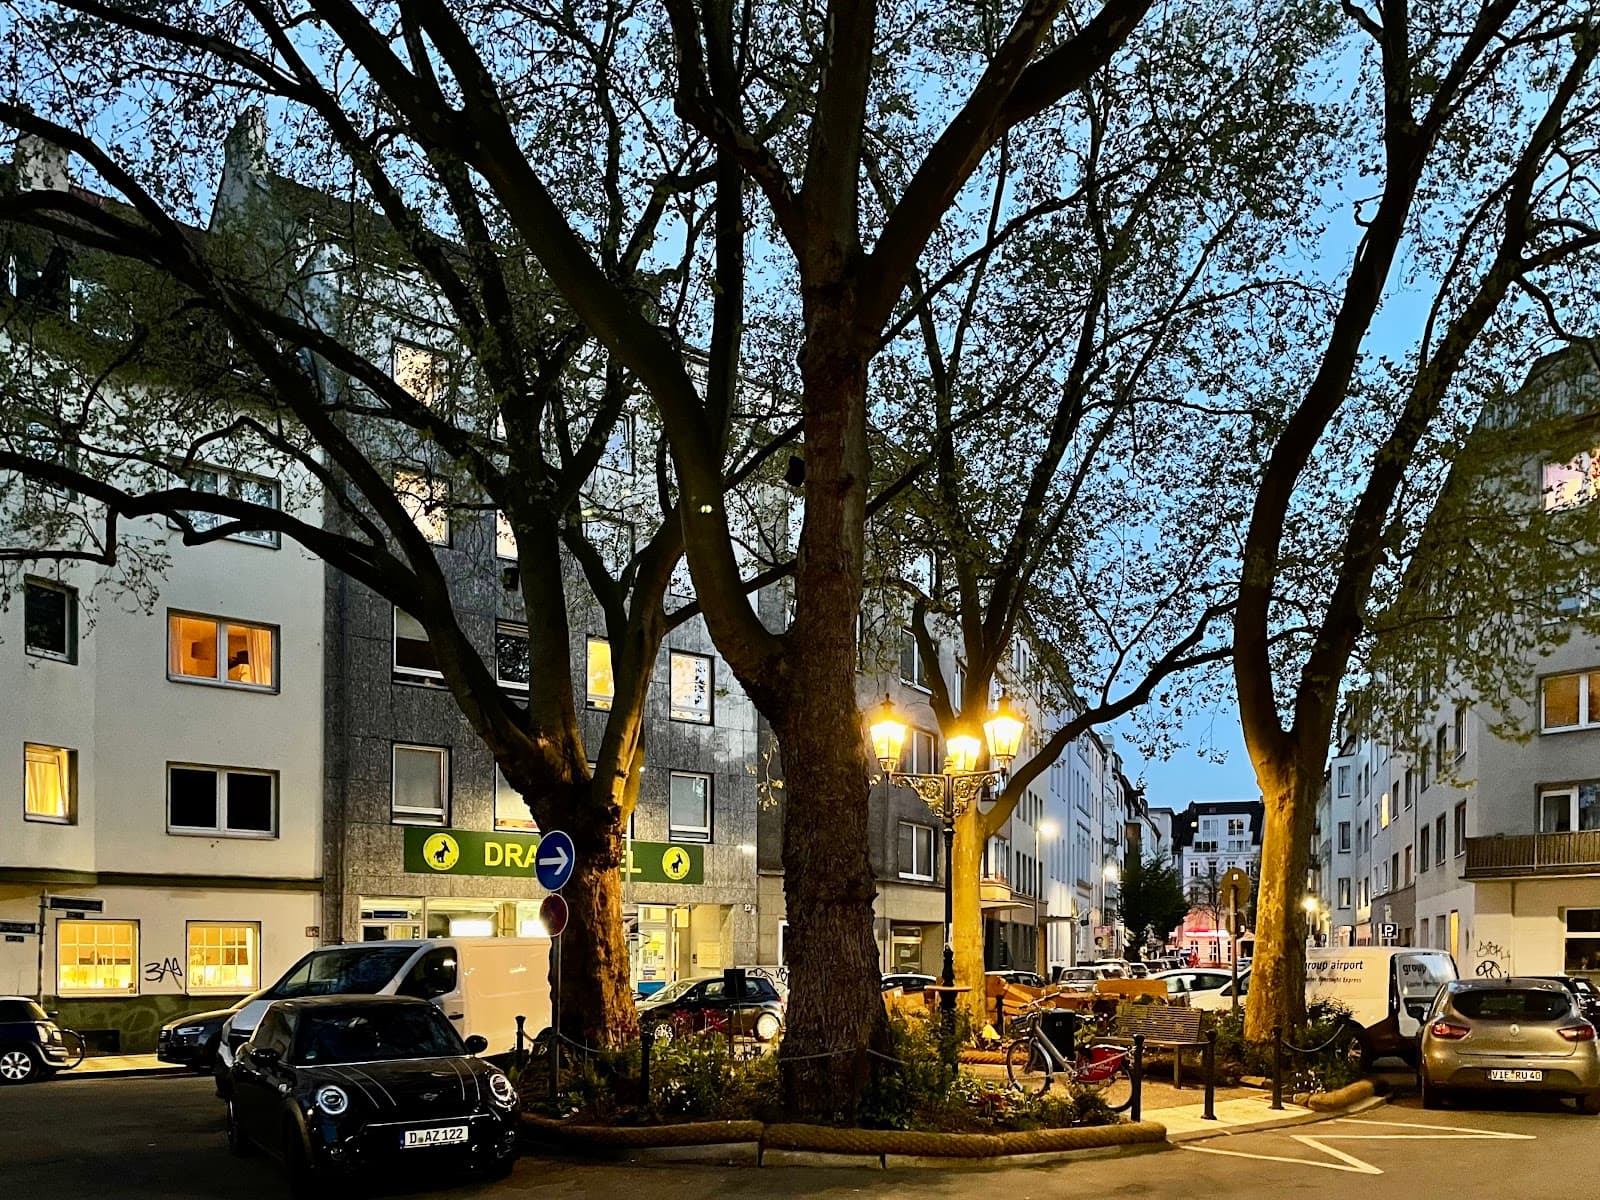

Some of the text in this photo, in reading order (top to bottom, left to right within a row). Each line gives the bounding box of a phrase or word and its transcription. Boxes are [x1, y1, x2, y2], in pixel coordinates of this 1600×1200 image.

[1384, 924, 1394, 937] P
[1330, 959, 1364, 972] airport
[1402, 963, 1427, 976] group
[1515, 1071, 1528, 1080] RU
[410, 1132, 417, 1144] D
